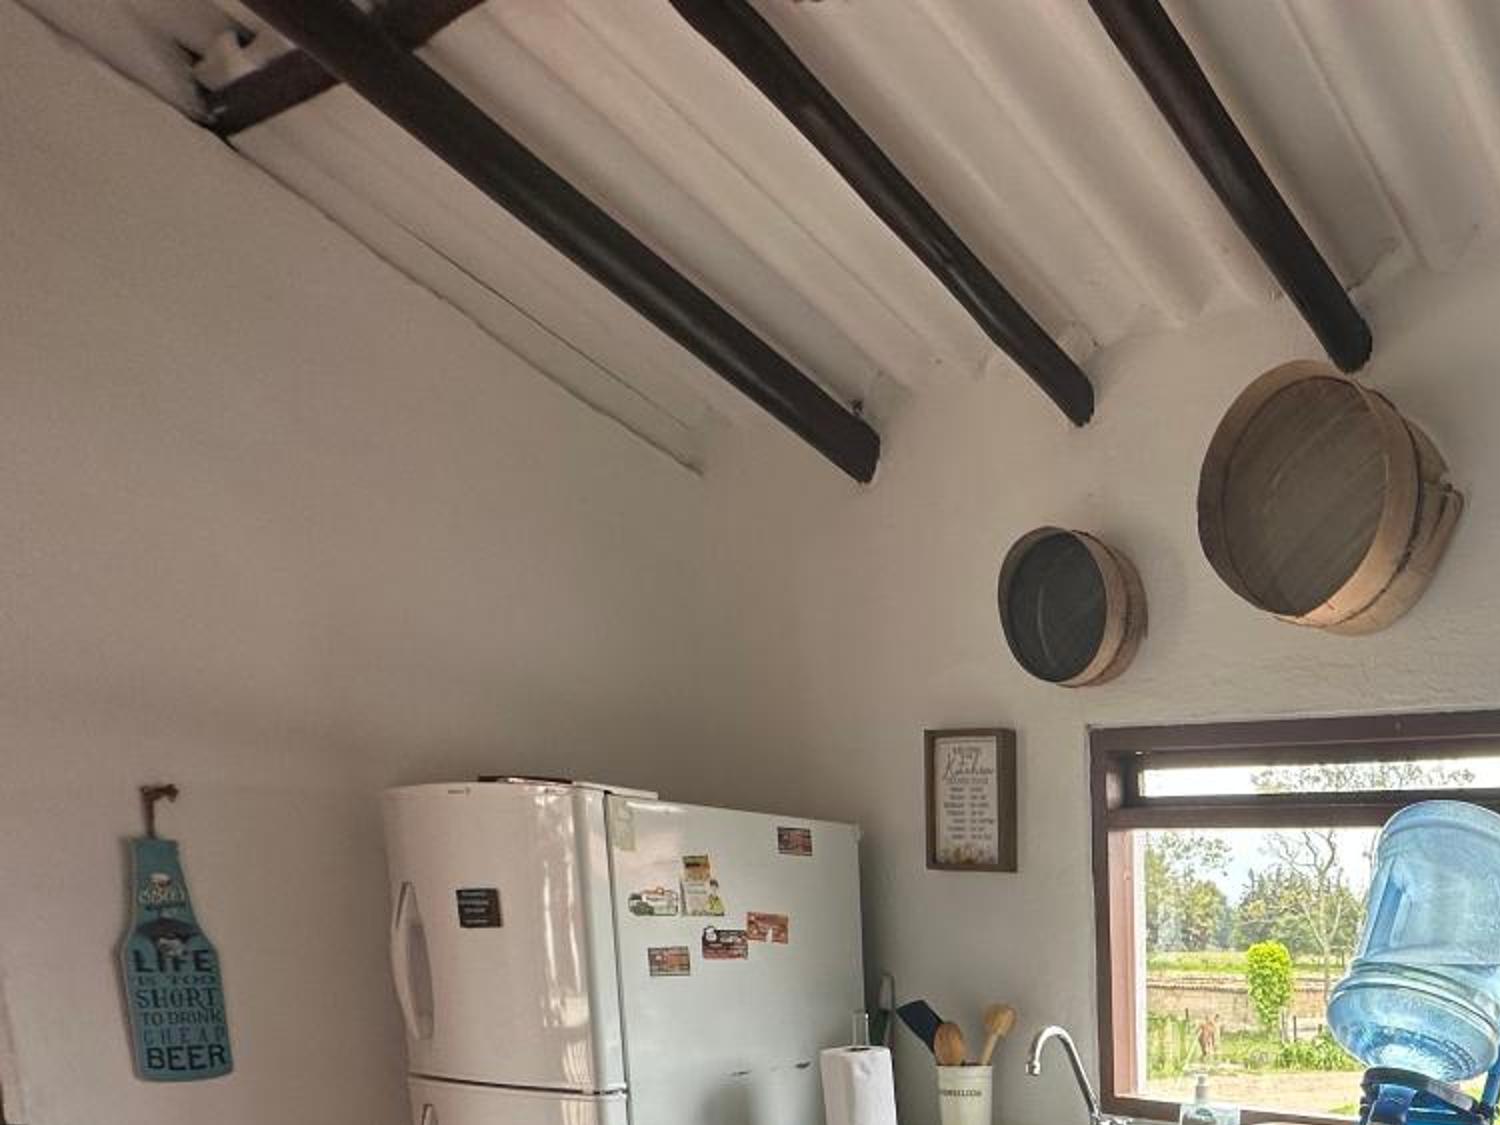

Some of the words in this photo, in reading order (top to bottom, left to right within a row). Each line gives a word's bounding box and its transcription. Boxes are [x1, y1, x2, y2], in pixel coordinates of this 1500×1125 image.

[134, 949, 212, 973] LIFE
[136, 987, 219, 1009] SHORT
[142, 1010, 163, 1026] TO
[167, 1008, 224, 1025] DRINK
[143, 1025, 226, 1046] CHEAP
[146, 1043, 227, 1071] BEER
